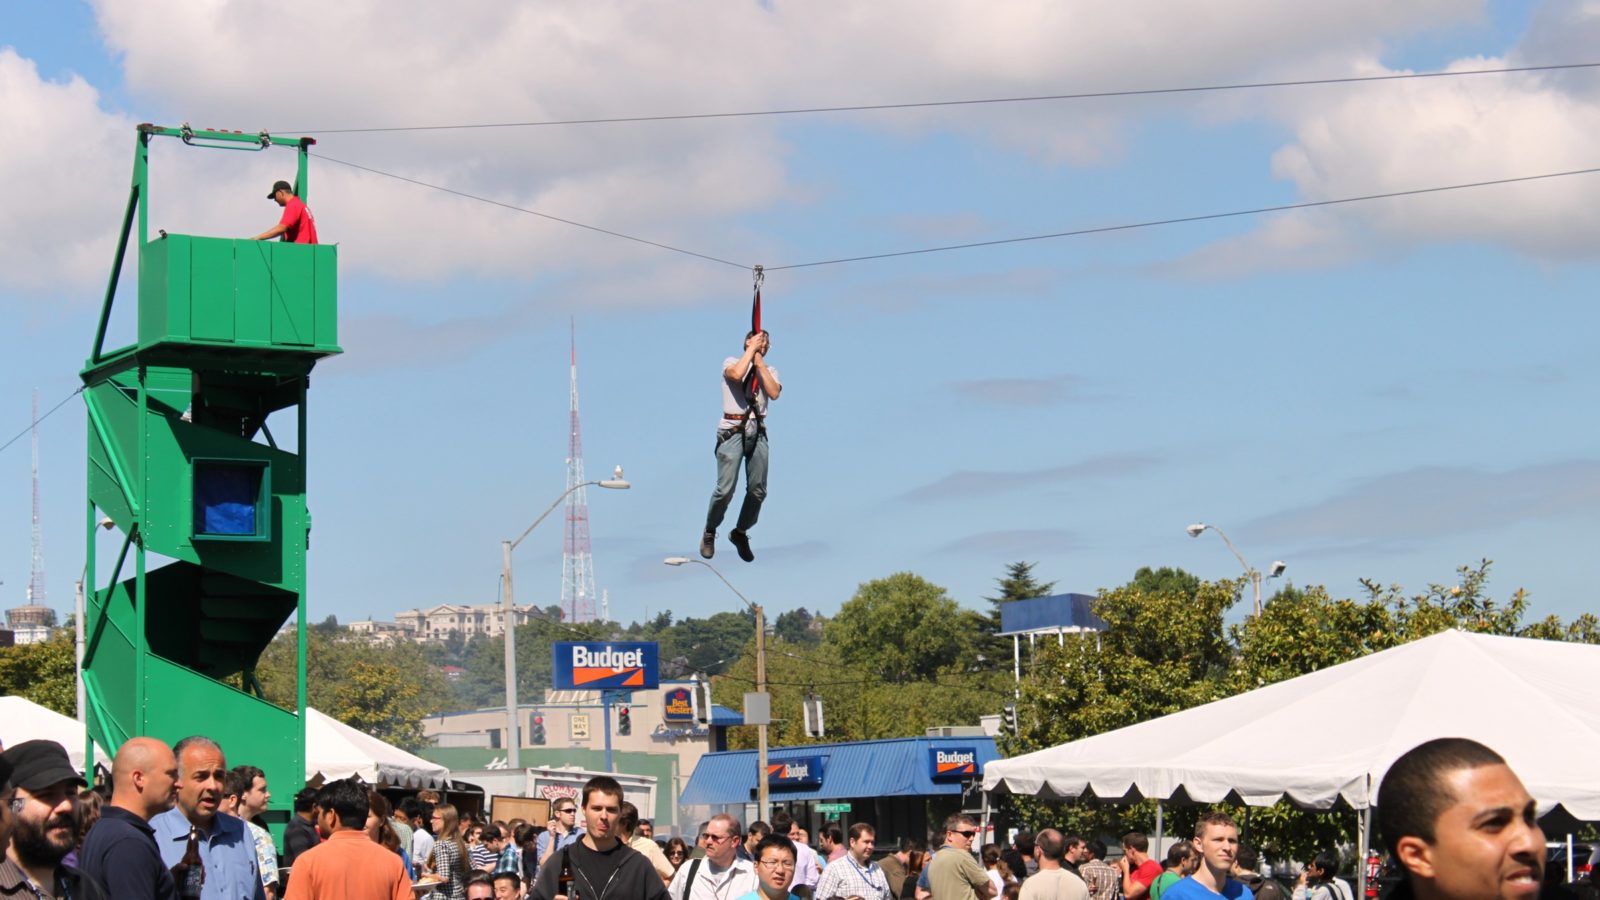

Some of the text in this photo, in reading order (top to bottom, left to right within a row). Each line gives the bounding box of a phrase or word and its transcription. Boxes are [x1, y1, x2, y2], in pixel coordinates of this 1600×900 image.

[573, 646, 644, 673] Budget
[672, 699, 688, 708] Best
[936, 751, 974, 766] Budget
[785, 764, 809, 781] Budget
[543, 783, 577, 797] CLOWNS
